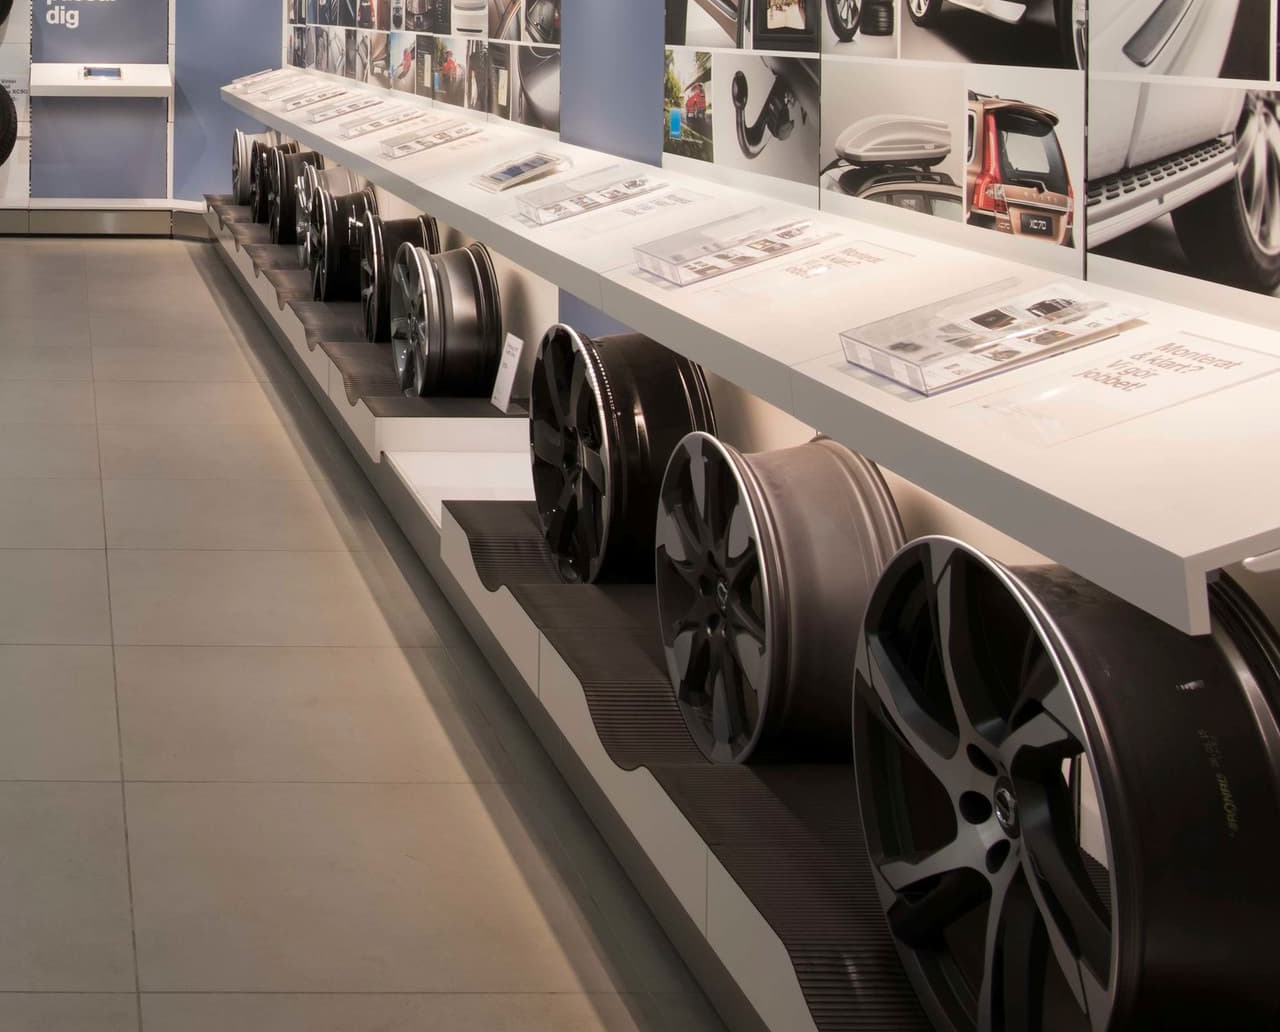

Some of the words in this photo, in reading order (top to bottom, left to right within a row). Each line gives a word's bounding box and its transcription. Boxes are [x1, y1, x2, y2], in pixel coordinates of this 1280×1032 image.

[46, 6, 80, 28] dig
[1029, 219, 1047, 231] XC70
[1145, 352, 1205, 375] klart?
[1155, 342, 1243, 370] Monterat
[1073, 367, 1149, 392] jobbet!
